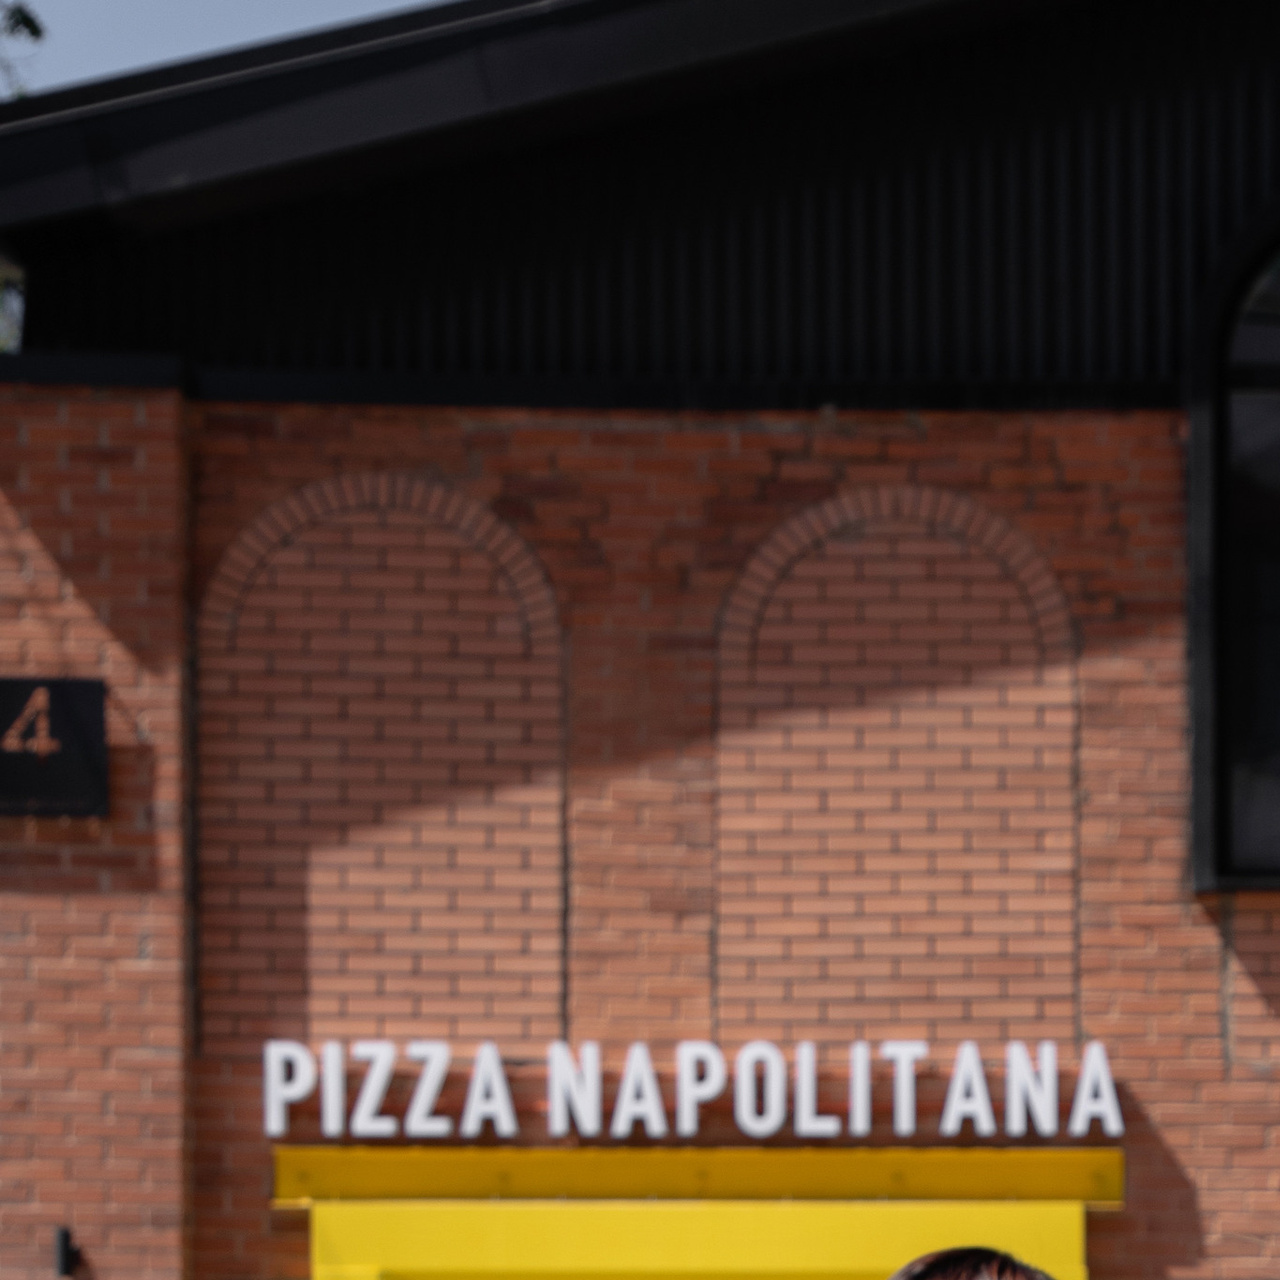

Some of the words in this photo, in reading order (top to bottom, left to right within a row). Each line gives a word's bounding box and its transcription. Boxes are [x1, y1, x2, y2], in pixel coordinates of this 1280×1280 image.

[1, 686, 61, 757] 4
[264, 1038, 519, 1138] PIZZA
[547, 1038, 1126, 1138] NAPOLITANA
